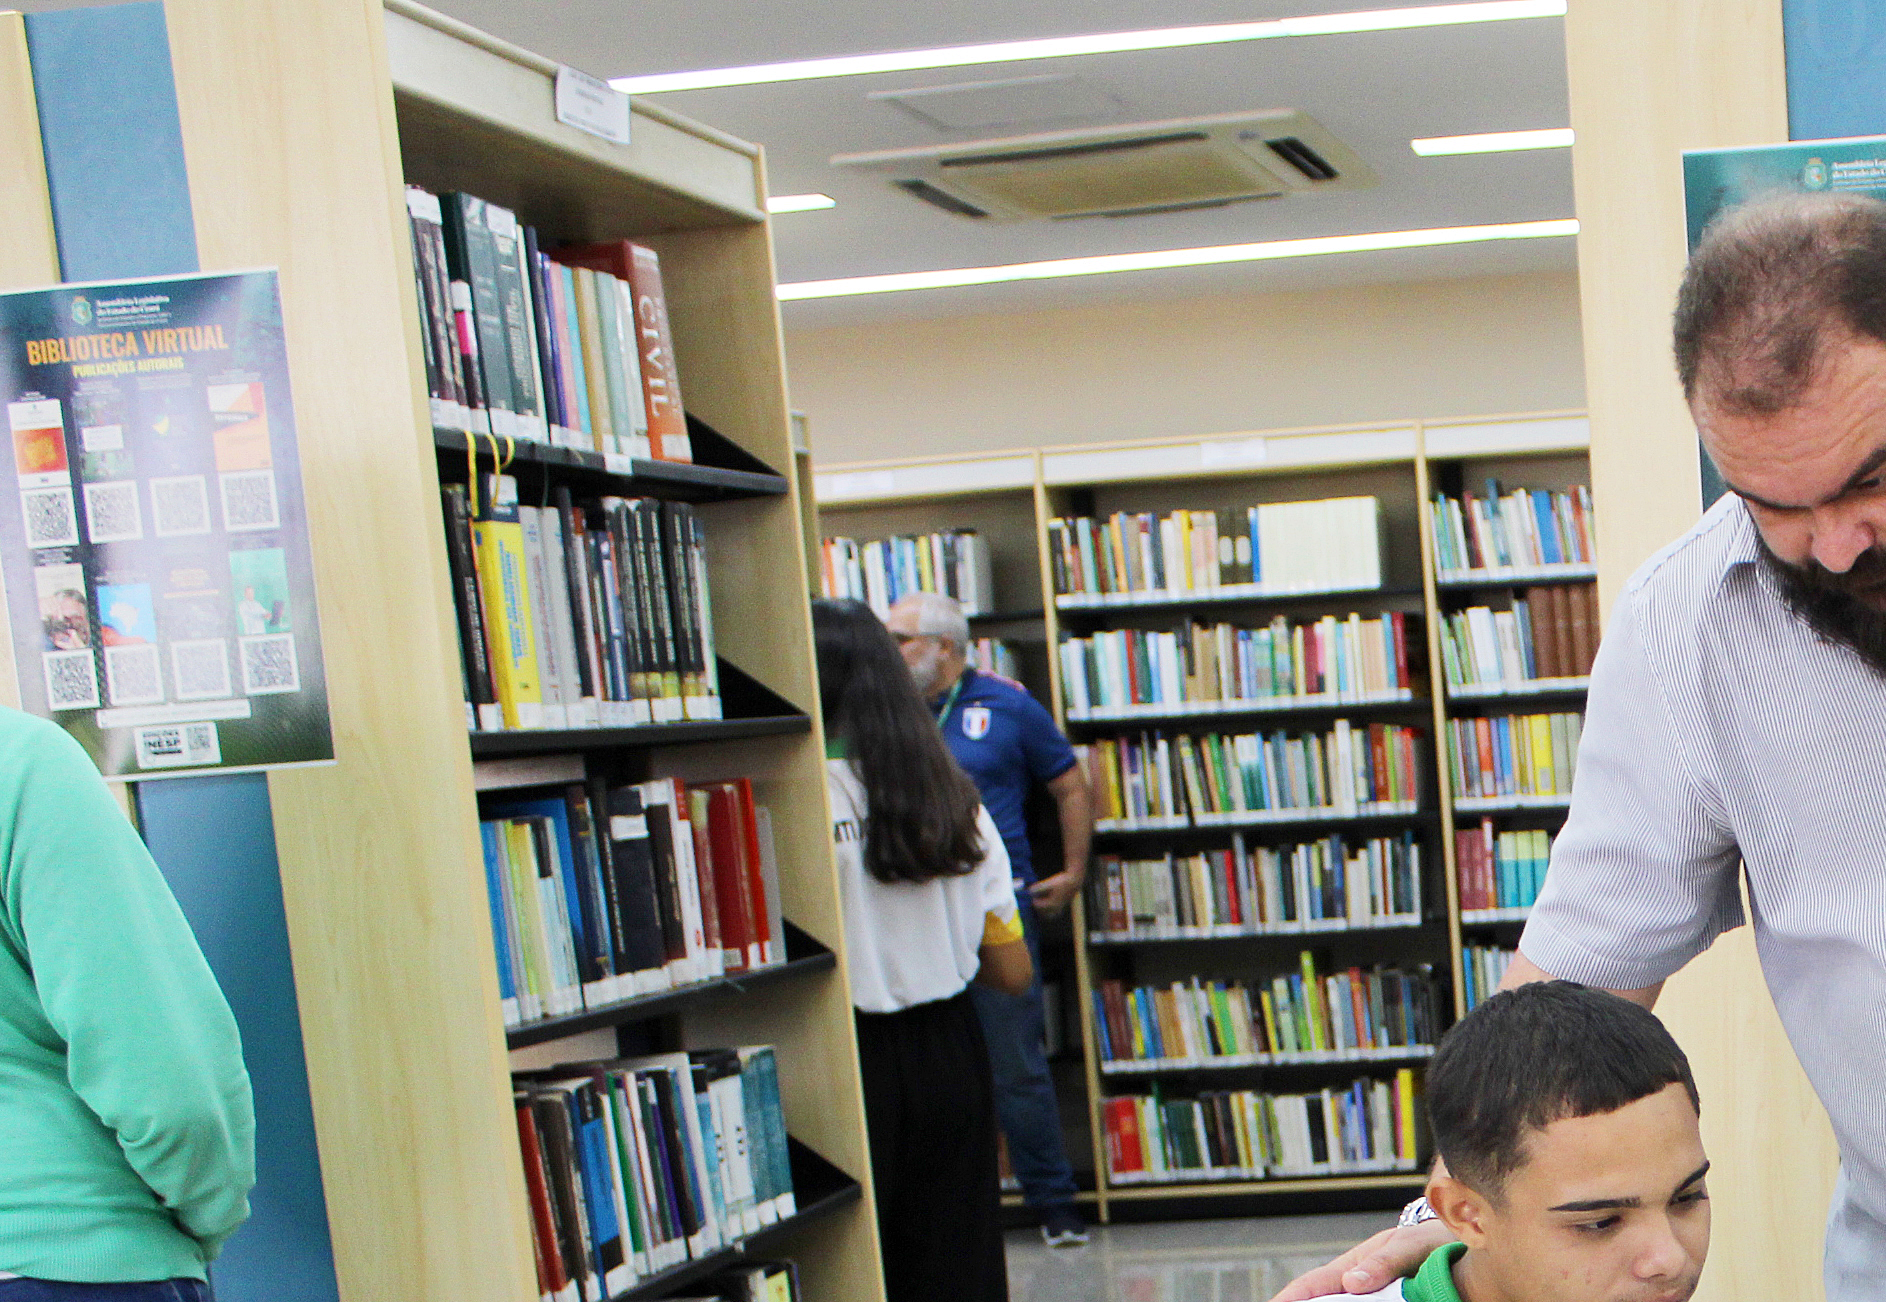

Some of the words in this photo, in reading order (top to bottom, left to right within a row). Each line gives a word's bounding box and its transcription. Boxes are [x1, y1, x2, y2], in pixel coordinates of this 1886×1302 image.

[26, 331, 139, 366] BIBLIOTECA
[142, 324, 229, 355] VIRTUAL
[638, 294, 669, 418] CIVIL
